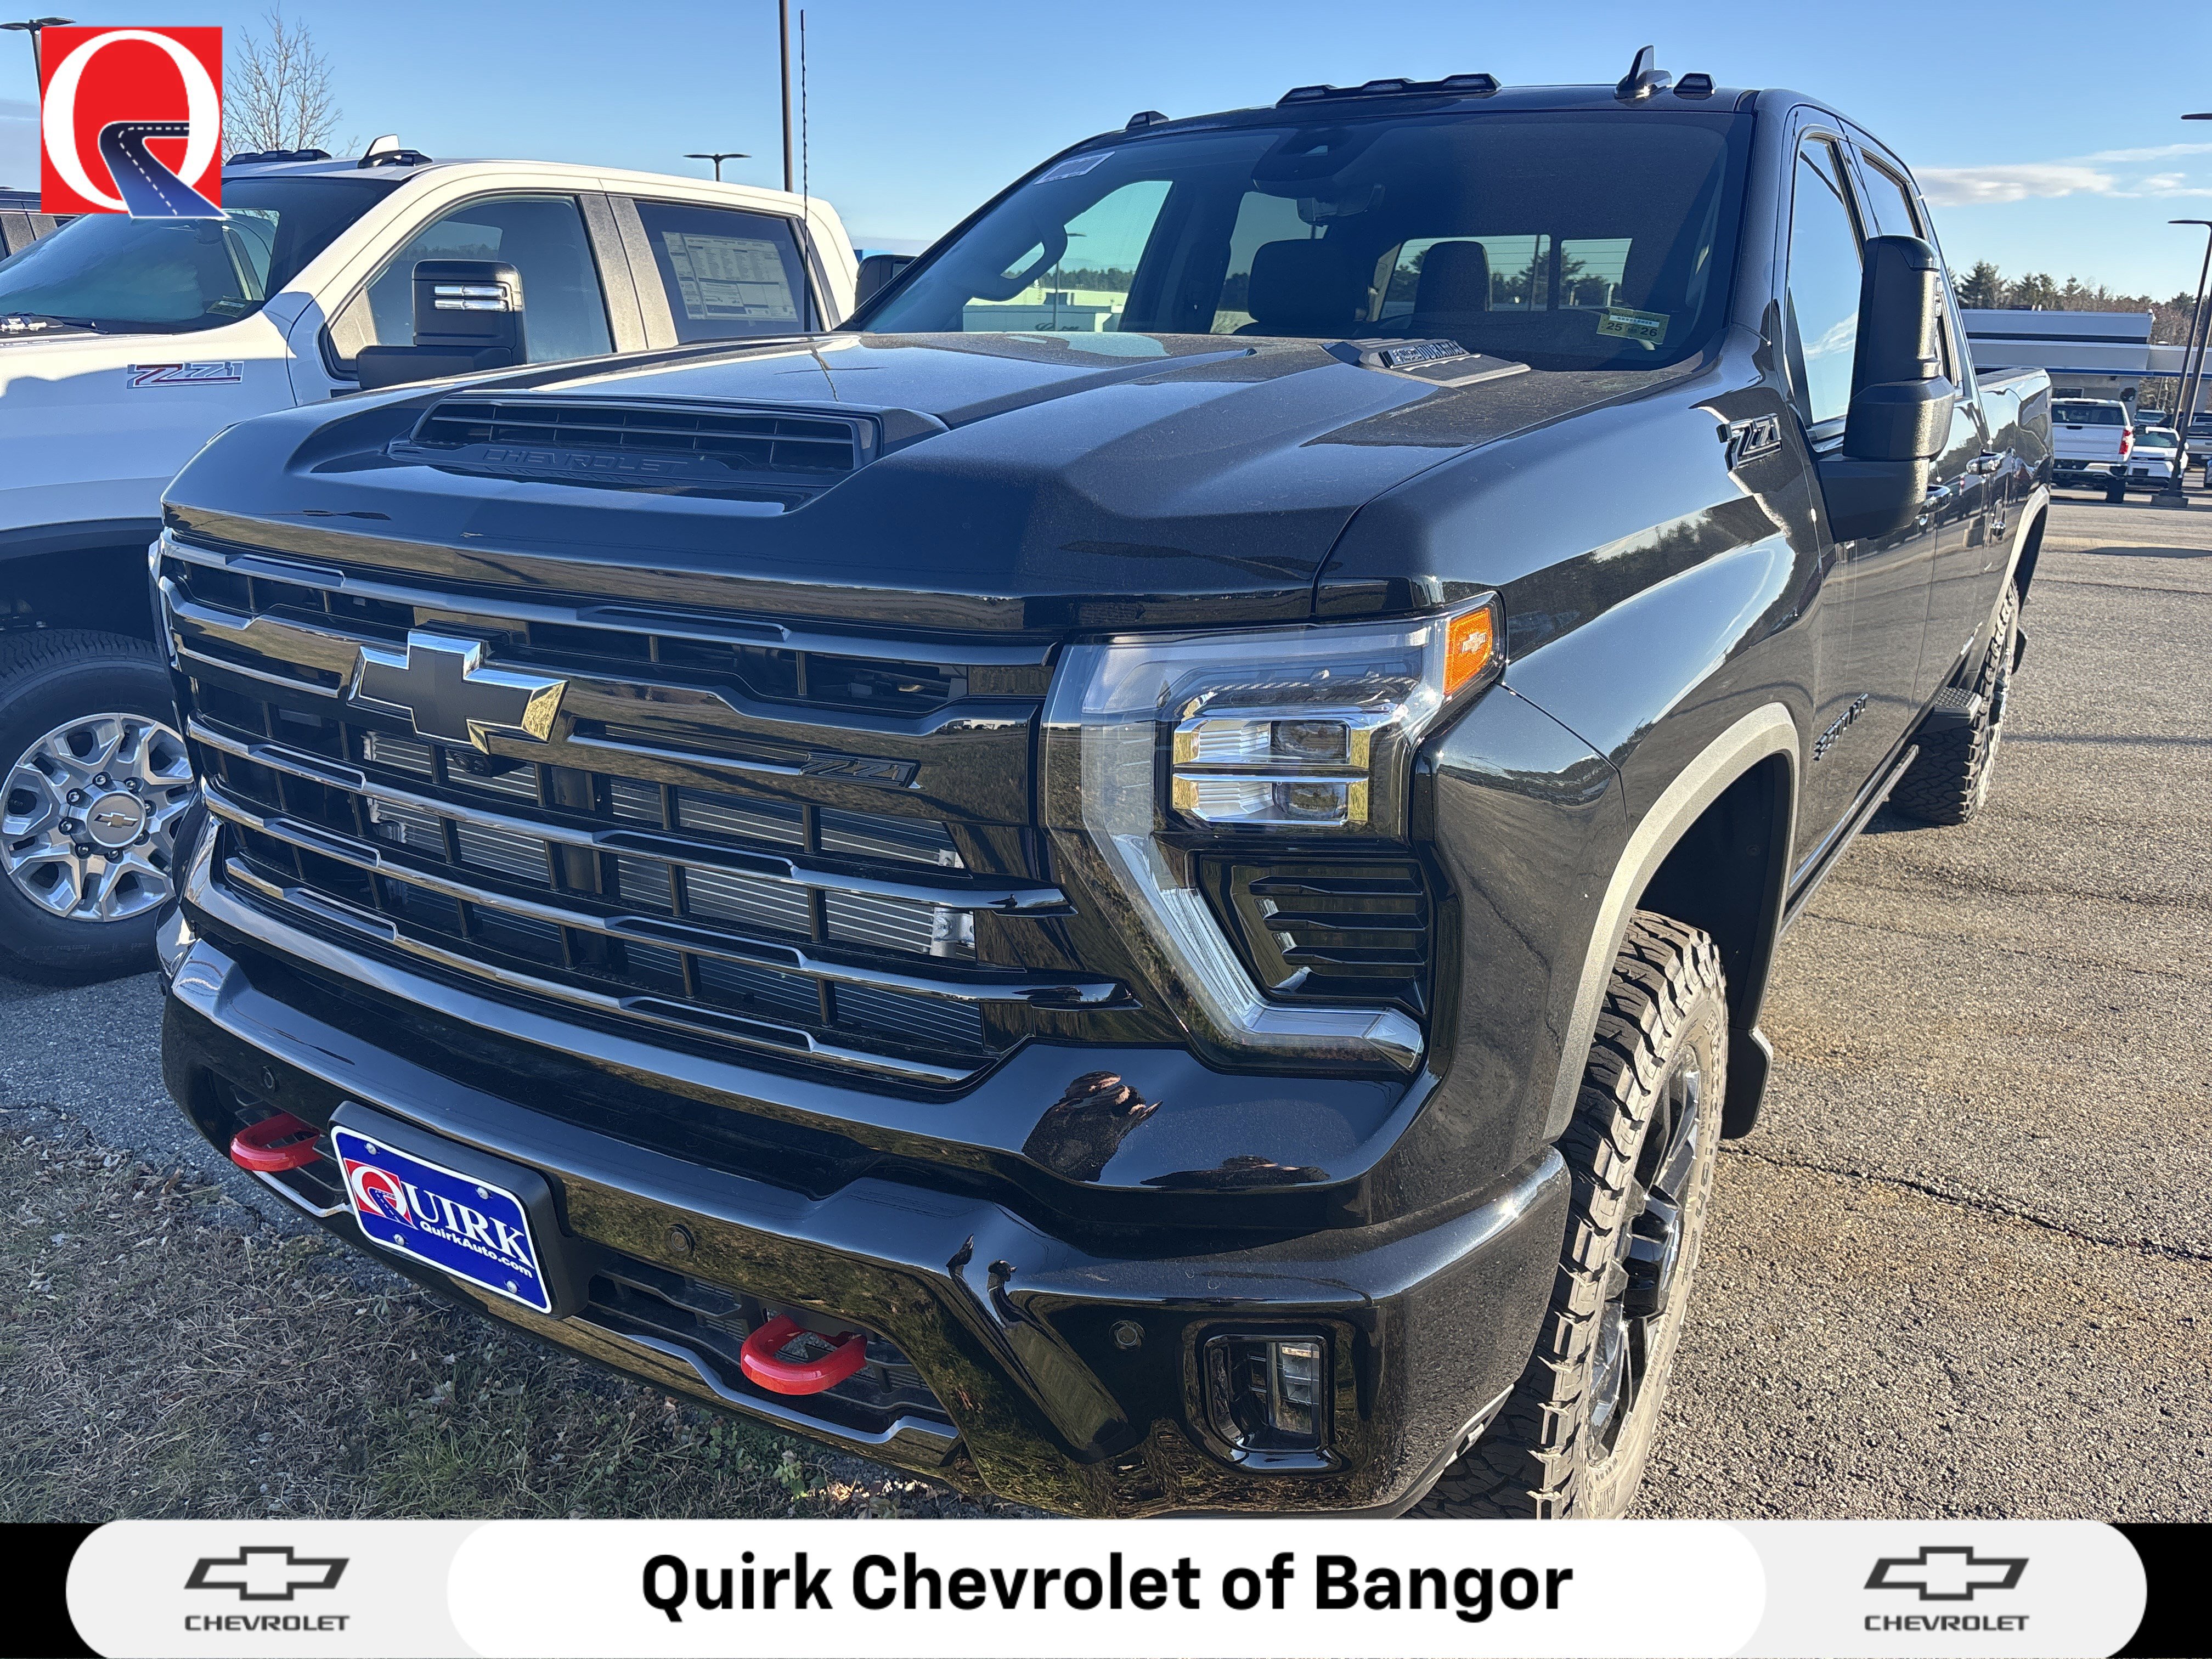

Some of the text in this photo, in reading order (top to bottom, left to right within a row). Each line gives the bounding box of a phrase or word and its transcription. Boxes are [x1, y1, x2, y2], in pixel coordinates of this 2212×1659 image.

[1606, 321, 1623, 331] 25
[1640, 327, 1658, 337] 26
[1414, 341, 1466, 360] DURAMAX
[483, 448, 689, 473] CHEVROLET
[350, 1164, 535, 1269] QUIRK
[419, 1220, 534, 1279] QuirkAuto.com
